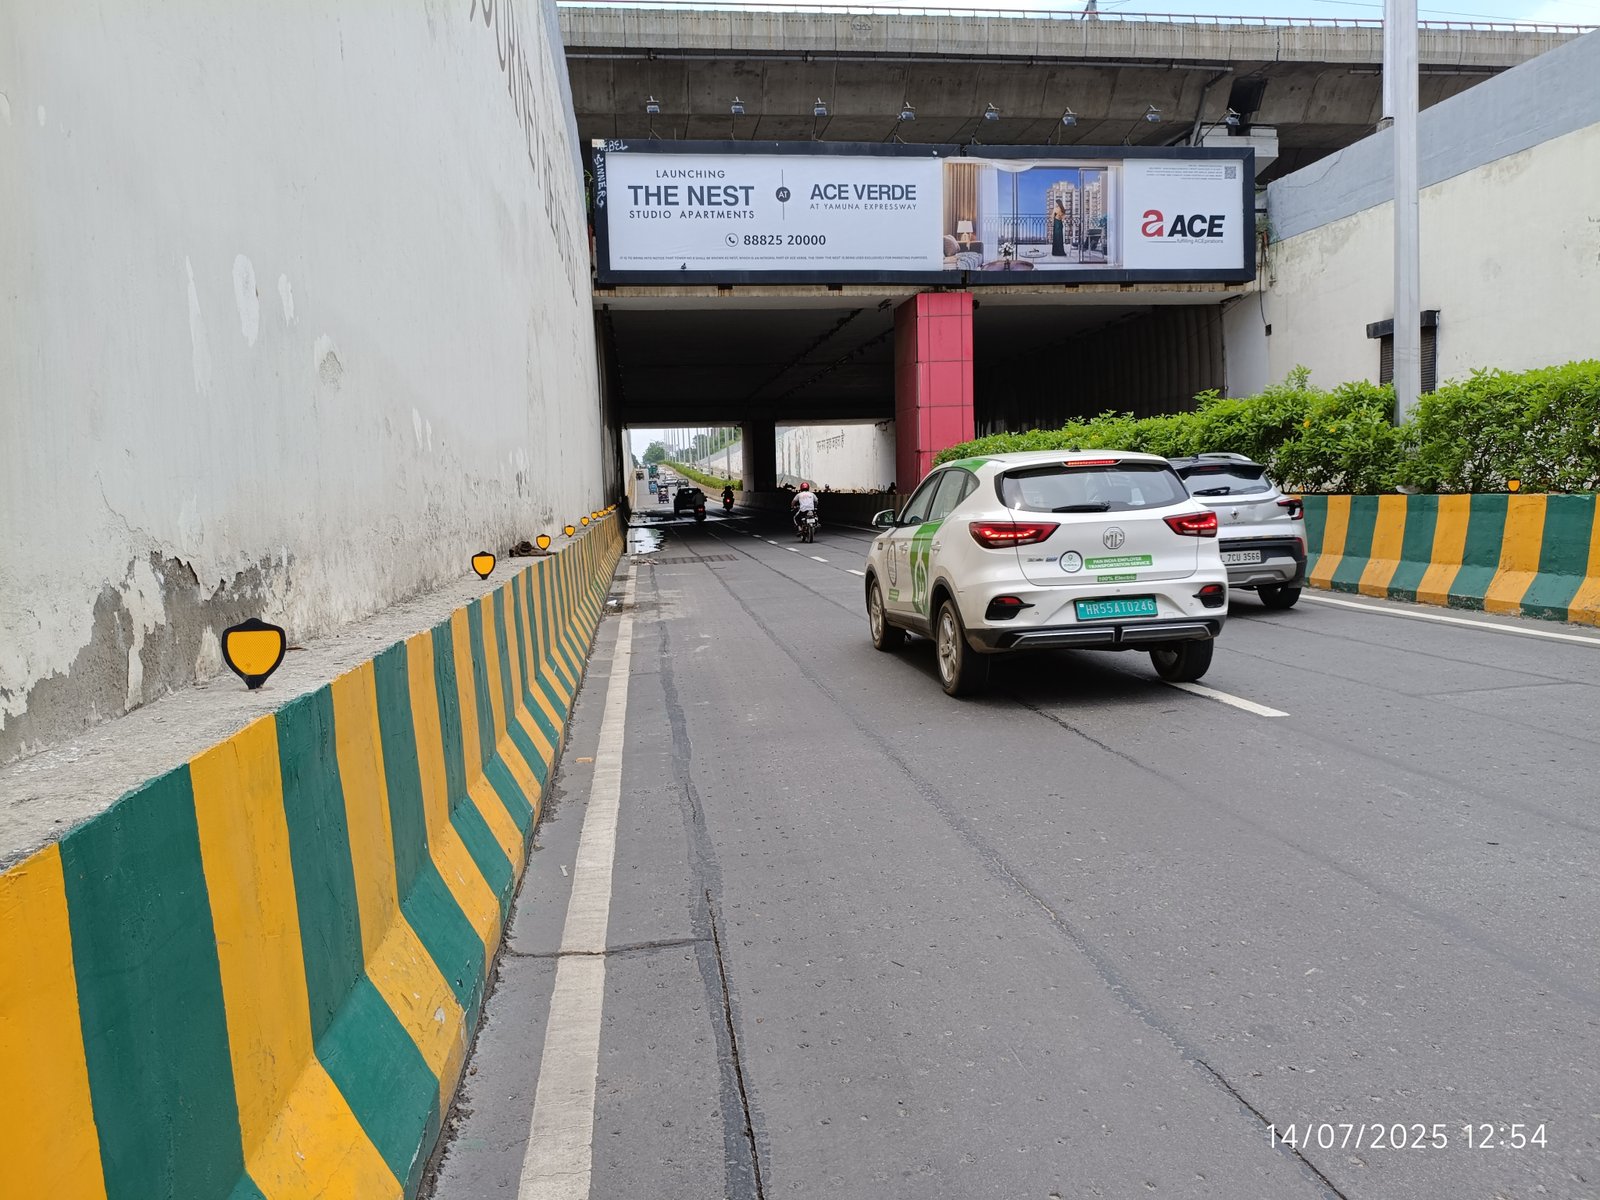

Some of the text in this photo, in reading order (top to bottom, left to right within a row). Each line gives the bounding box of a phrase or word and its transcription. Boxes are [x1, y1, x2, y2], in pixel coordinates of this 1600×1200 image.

[656, 170, 725, 179] LAUNCHING
[627, 185, 755, 206] THE NEST
[810, 184, 917, 201] ACE VERDE
[629, 210, 755, 219] STUDIO APARTMENTS
[1167, 214, 1226, 238] ACE
[743, 234, 827, 246] 88825 20000
[1227, 553, 1241, 562] 7CU
